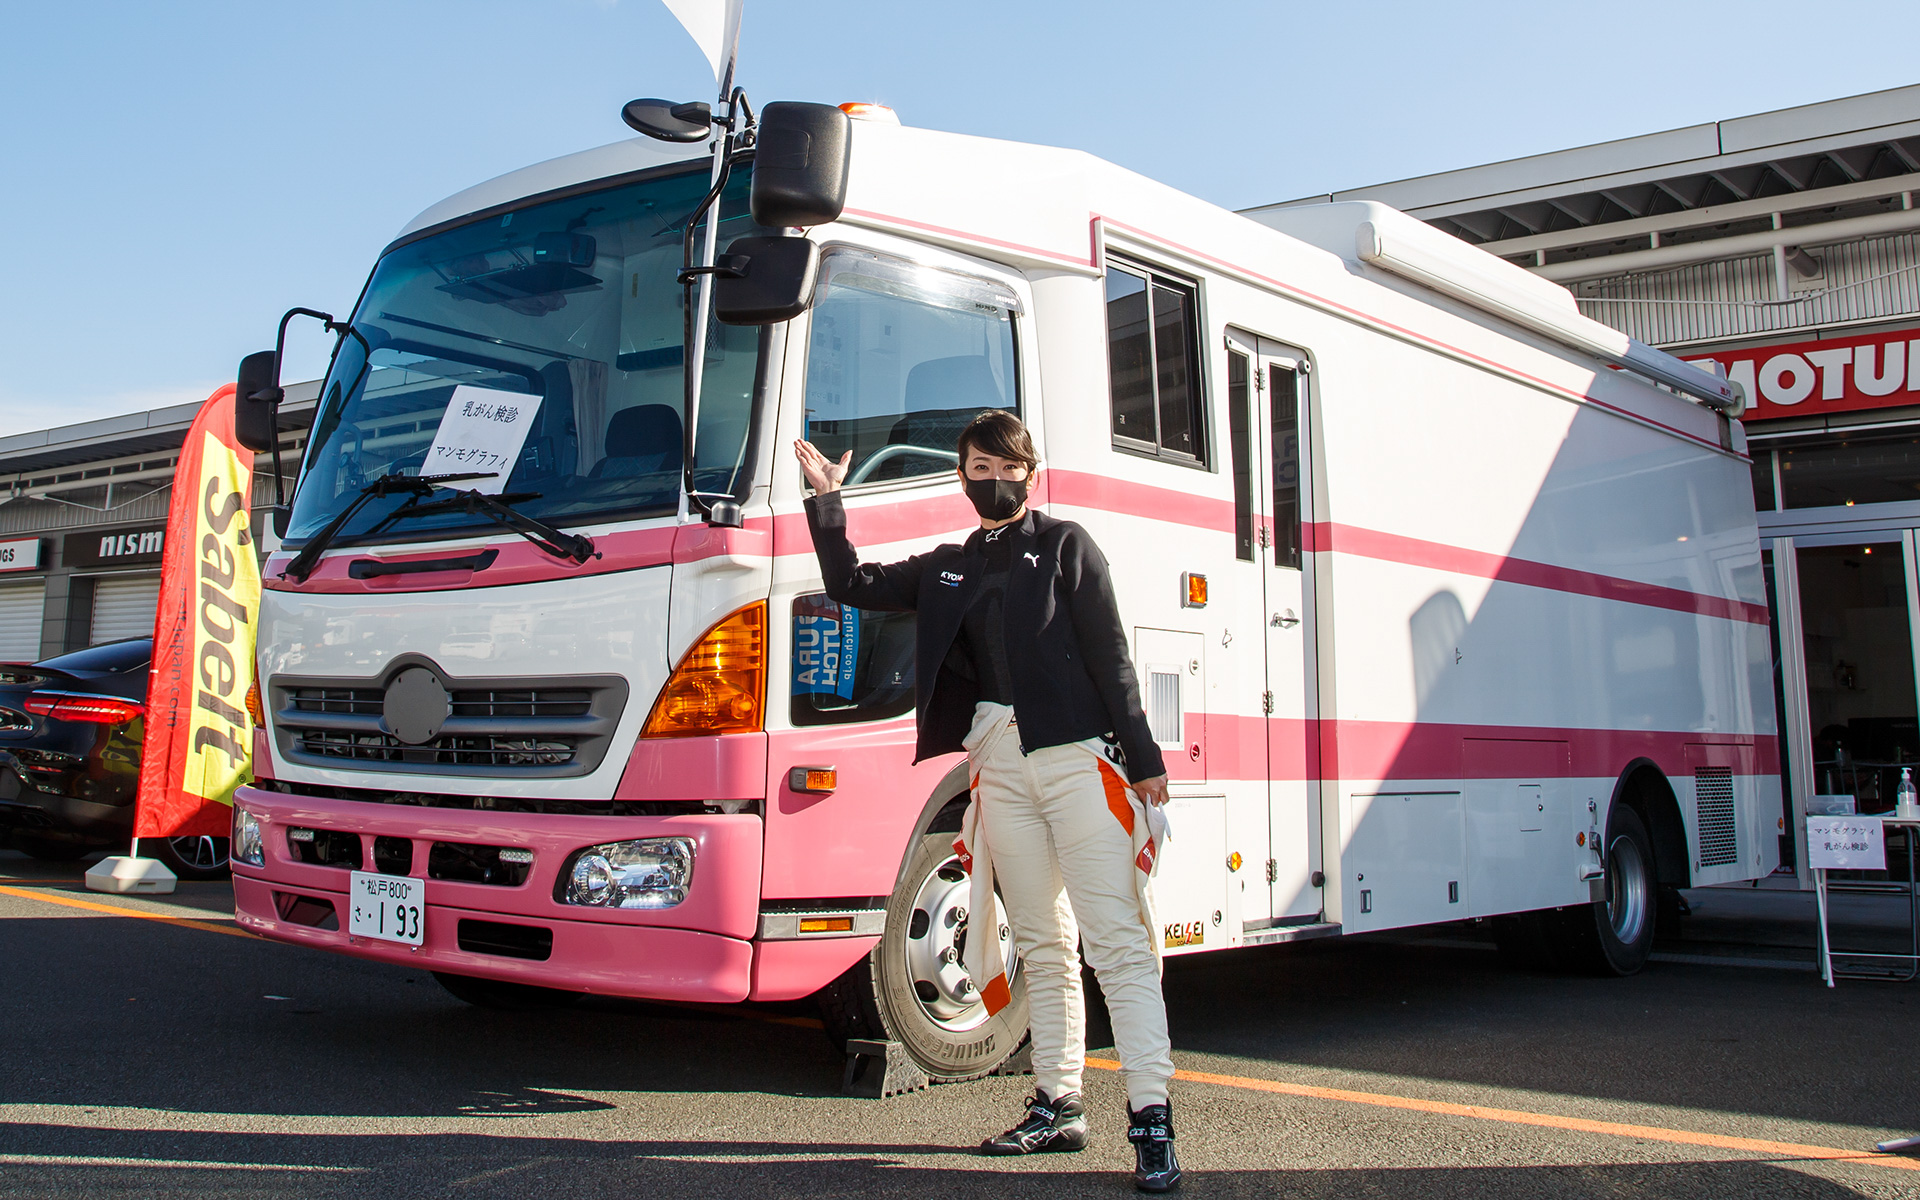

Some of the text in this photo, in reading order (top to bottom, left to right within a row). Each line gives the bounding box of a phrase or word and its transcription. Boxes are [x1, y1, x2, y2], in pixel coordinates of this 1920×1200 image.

[462, 400, 519, 424] 乳がん検診
[436, 446, 508, 470] マンモグラフィ
[0, 547, 15, 562] GS
[195, 476, 251, 769] Sabelt
[1814, 827, 1875, 836] マンモグラフィ
[1824, 842, 1869, 851] 乳がん検診
[892, 986, 996, 1060] BRIDGESTONE
